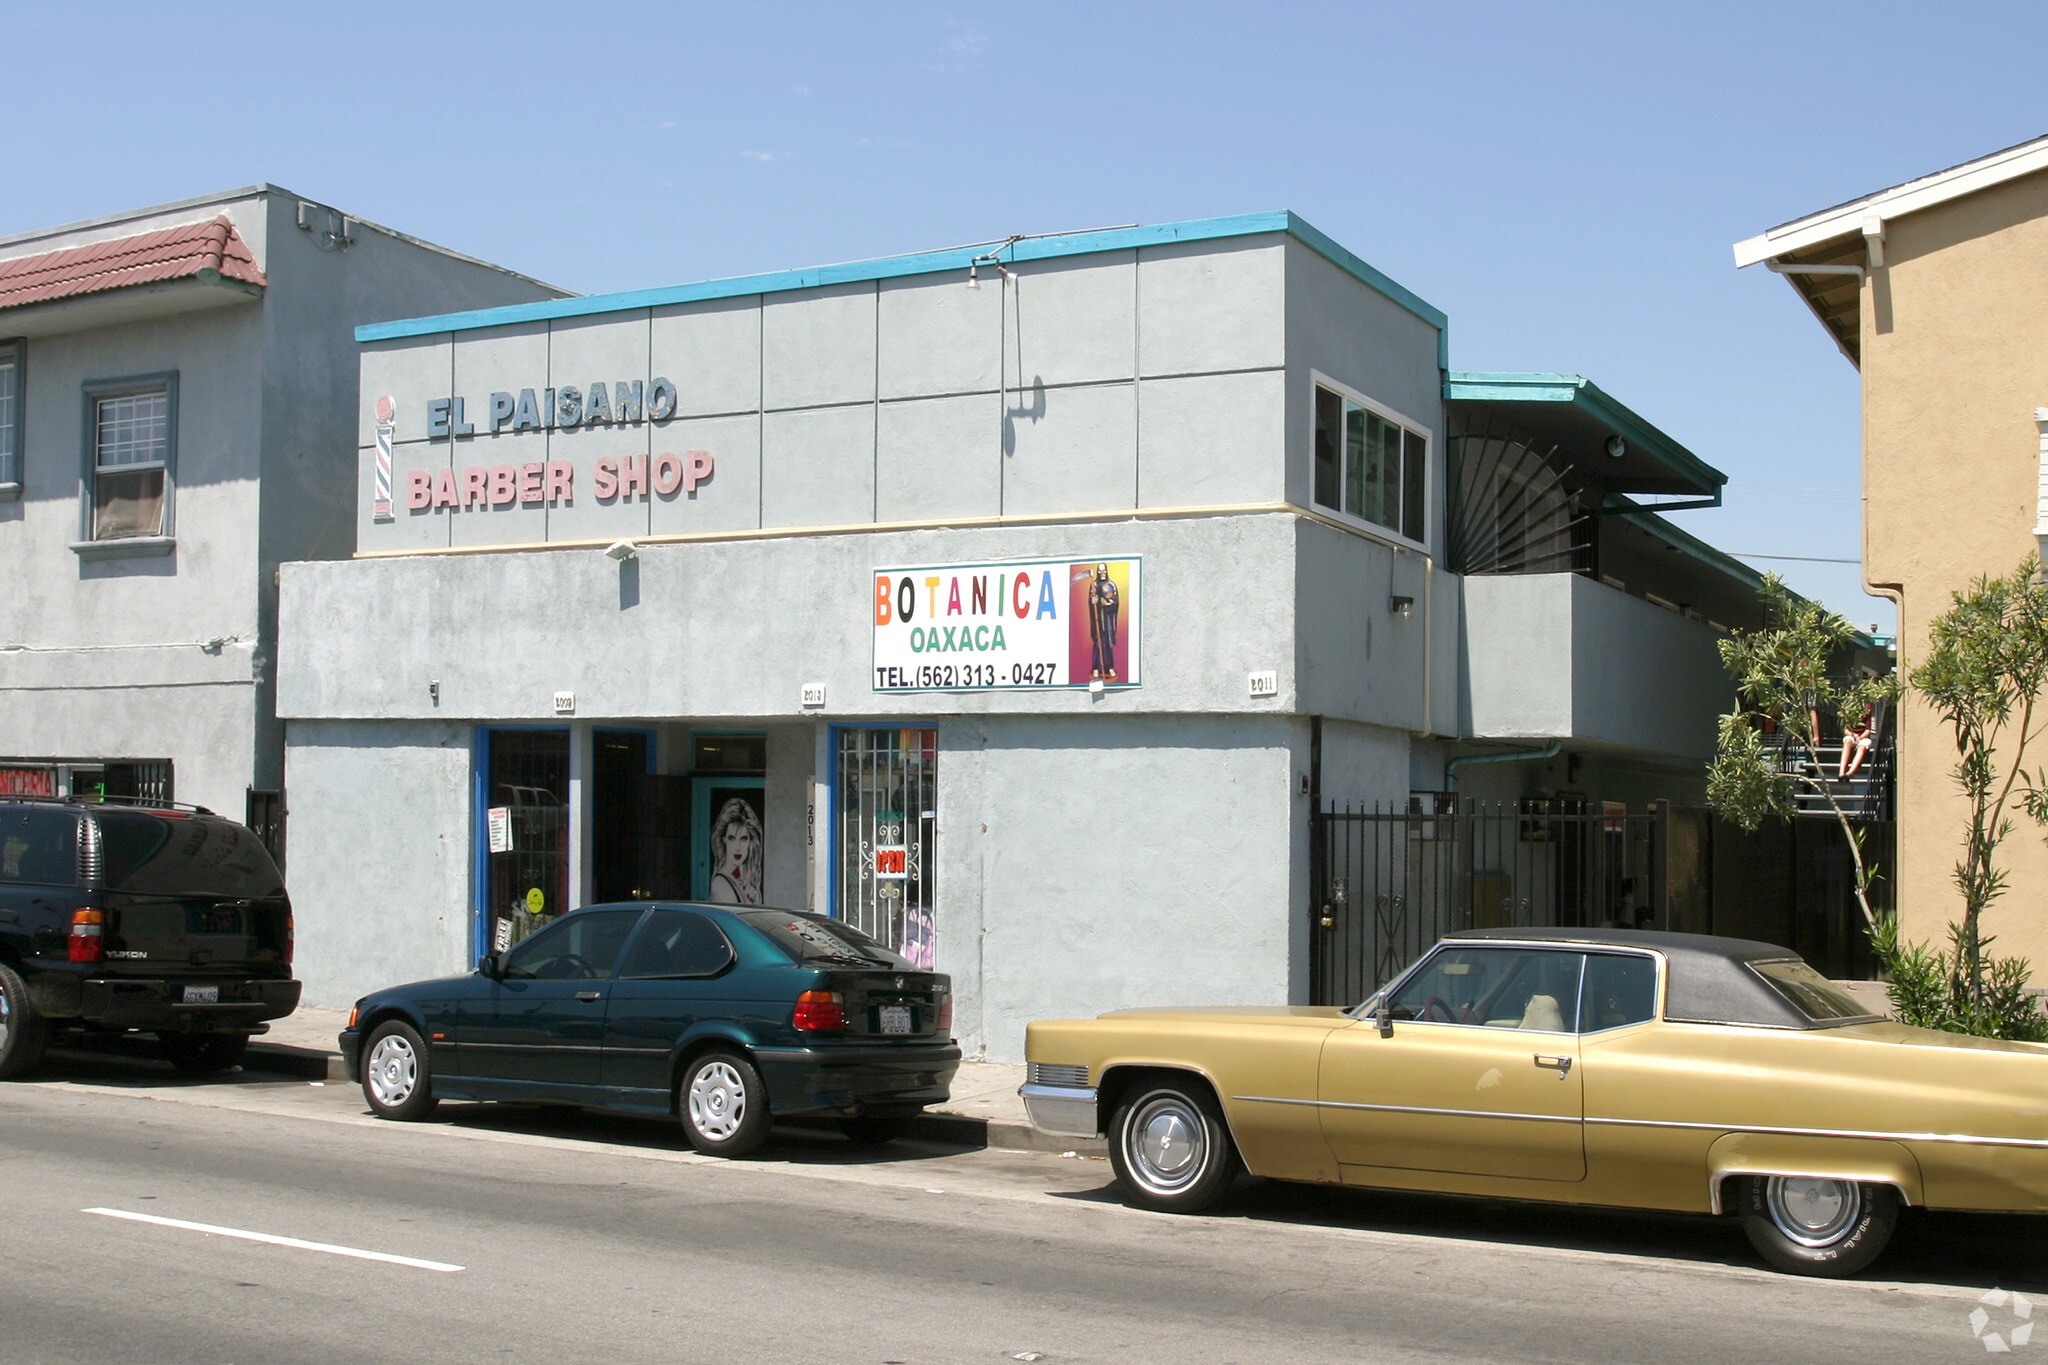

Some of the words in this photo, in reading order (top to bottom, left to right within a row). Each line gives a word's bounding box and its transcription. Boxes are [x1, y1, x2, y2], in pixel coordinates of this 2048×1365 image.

[427, 396, 475, 438] EL
[490, 377, 677, 431] PAISANO
[407, 460, 574, 510] BARBER
[593, 450, 714, 500] SHOP
[875, 570, 1057, 626] BOTANICA
[910, 625, 1007, 653] OAXACA
[1250, 677, 1272, 692] 2011
[807, 804, 815, 846] 2013
[105, 951, 148, 959] YUKON
[1843, 1187, 1873, 1249] RADIAL
[1814, 1250, 1838, 1261] LT
